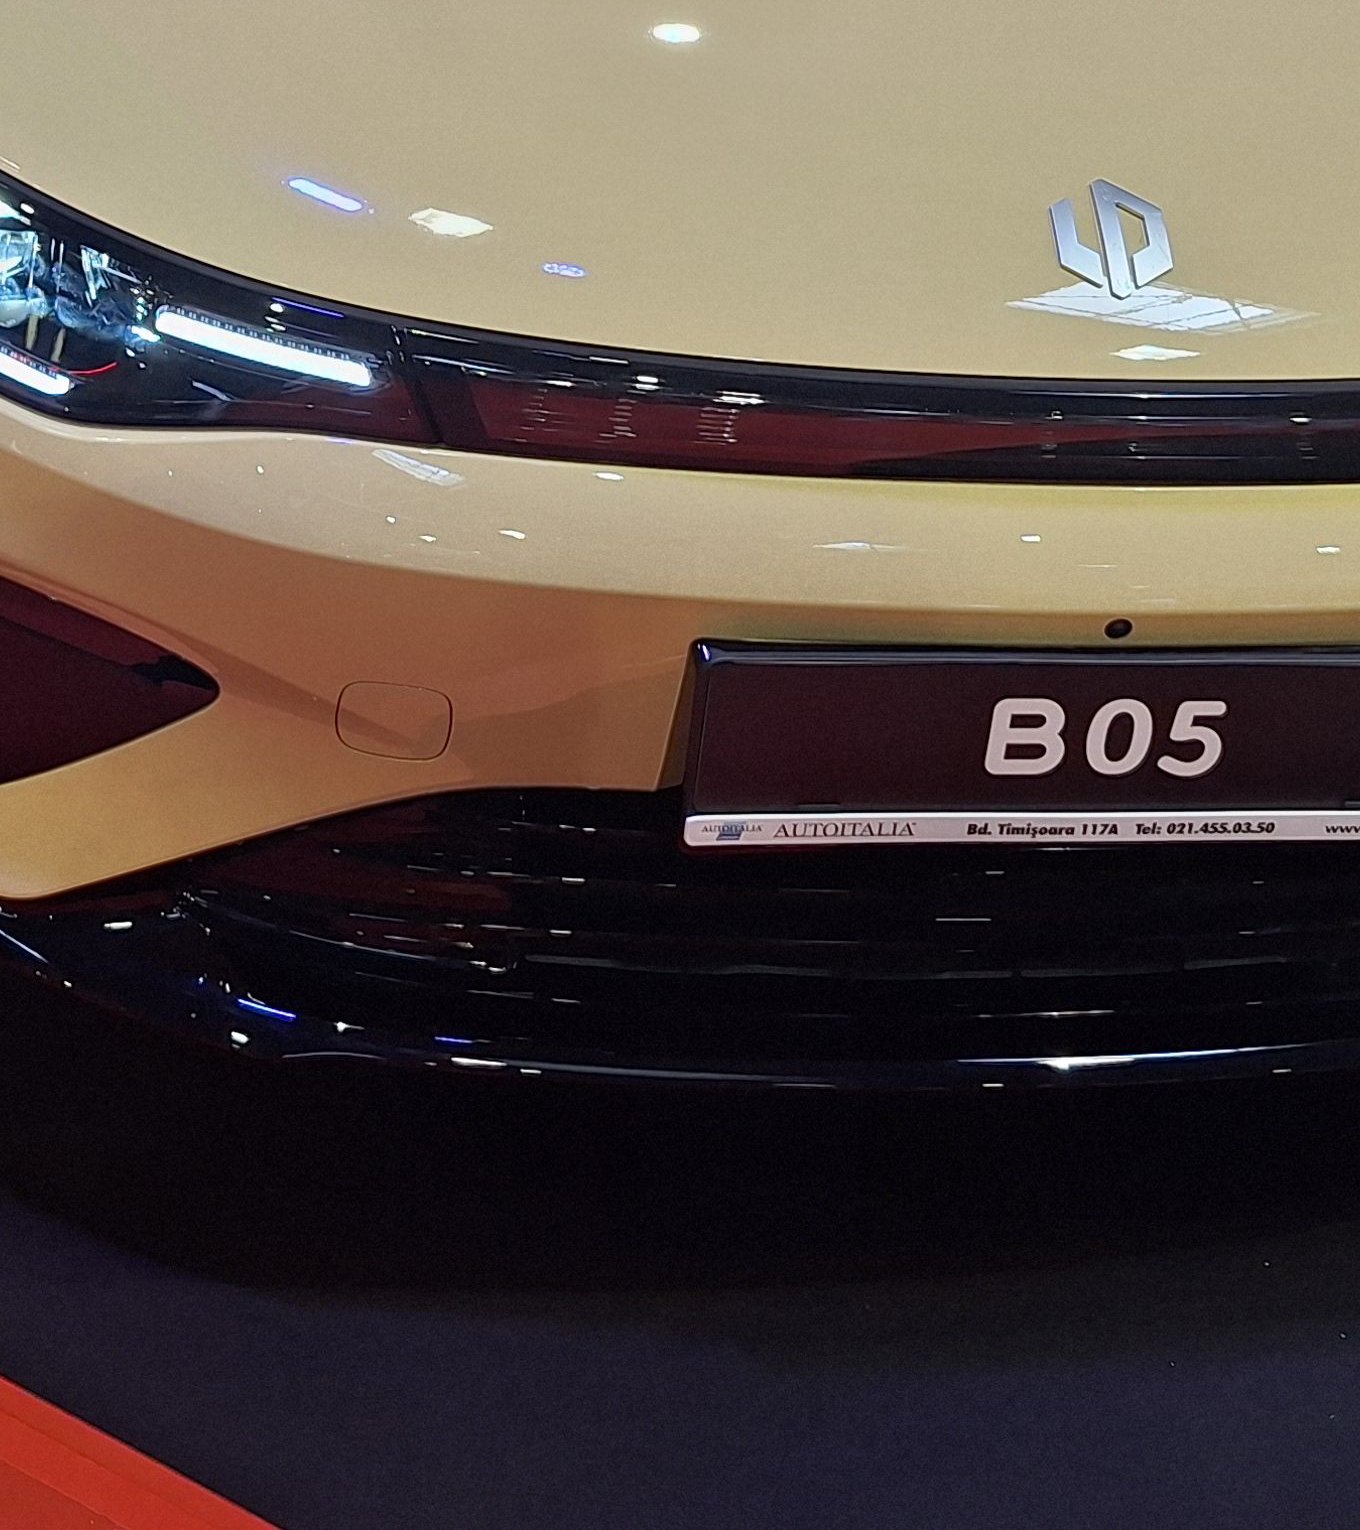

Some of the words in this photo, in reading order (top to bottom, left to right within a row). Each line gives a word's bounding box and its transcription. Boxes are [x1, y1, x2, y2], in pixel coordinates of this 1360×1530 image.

[772, 822, 916, 838] AUTOITALIA
[966, 823, 992, 835] Bd.
[1081, 823, 1119, 835] 117A
[1136, 822, 1162, 835] Tel:
[1166, 822, 1275, 834] 021.455.03.50
